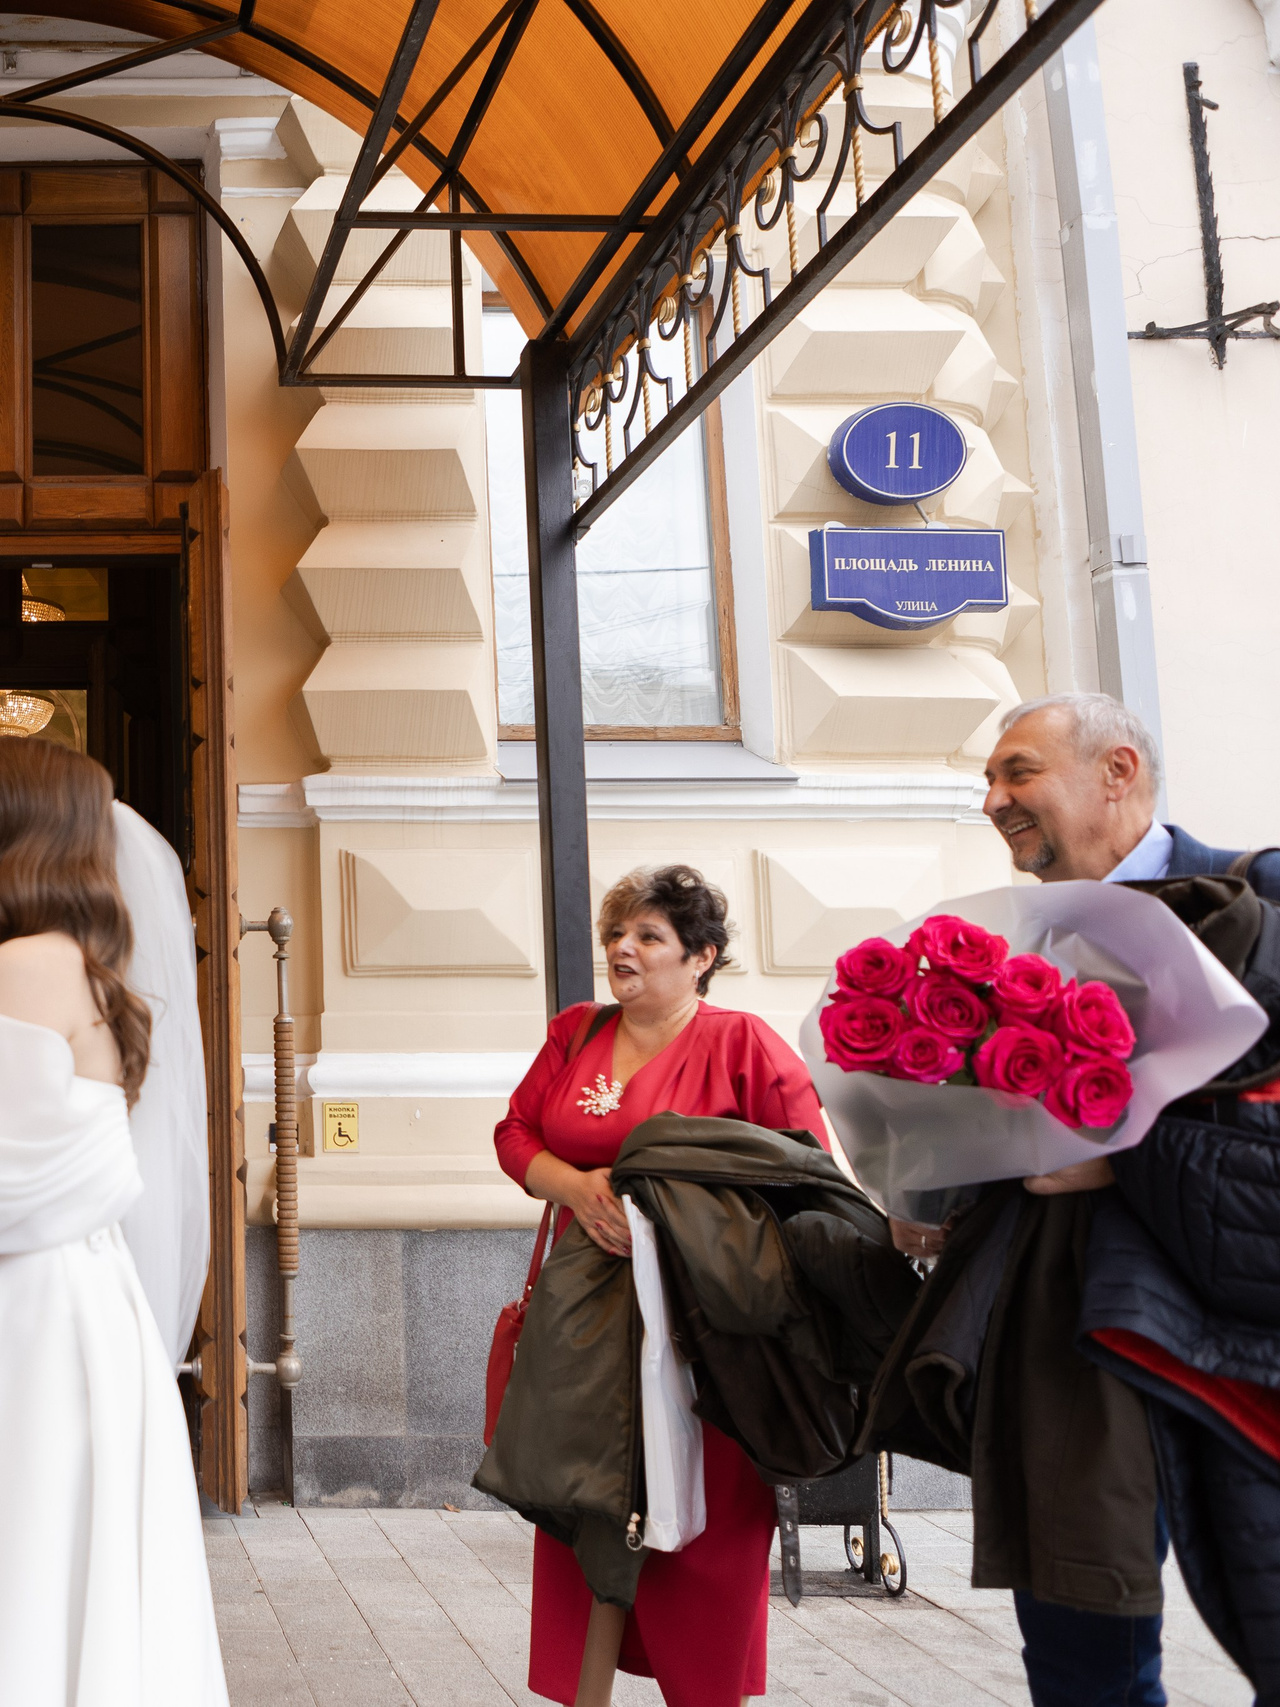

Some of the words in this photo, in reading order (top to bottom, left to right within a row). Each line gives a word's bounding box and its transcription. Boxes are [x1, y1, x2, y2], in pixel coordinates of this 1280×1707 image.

[884, 431, 924, 470] 11
[834, 557, 919, 573] ПЛОЩАДЬ
[925, 559, 995, 572] ЛЕНИНА
[895, 600, 939, 612] УЛИЦА
